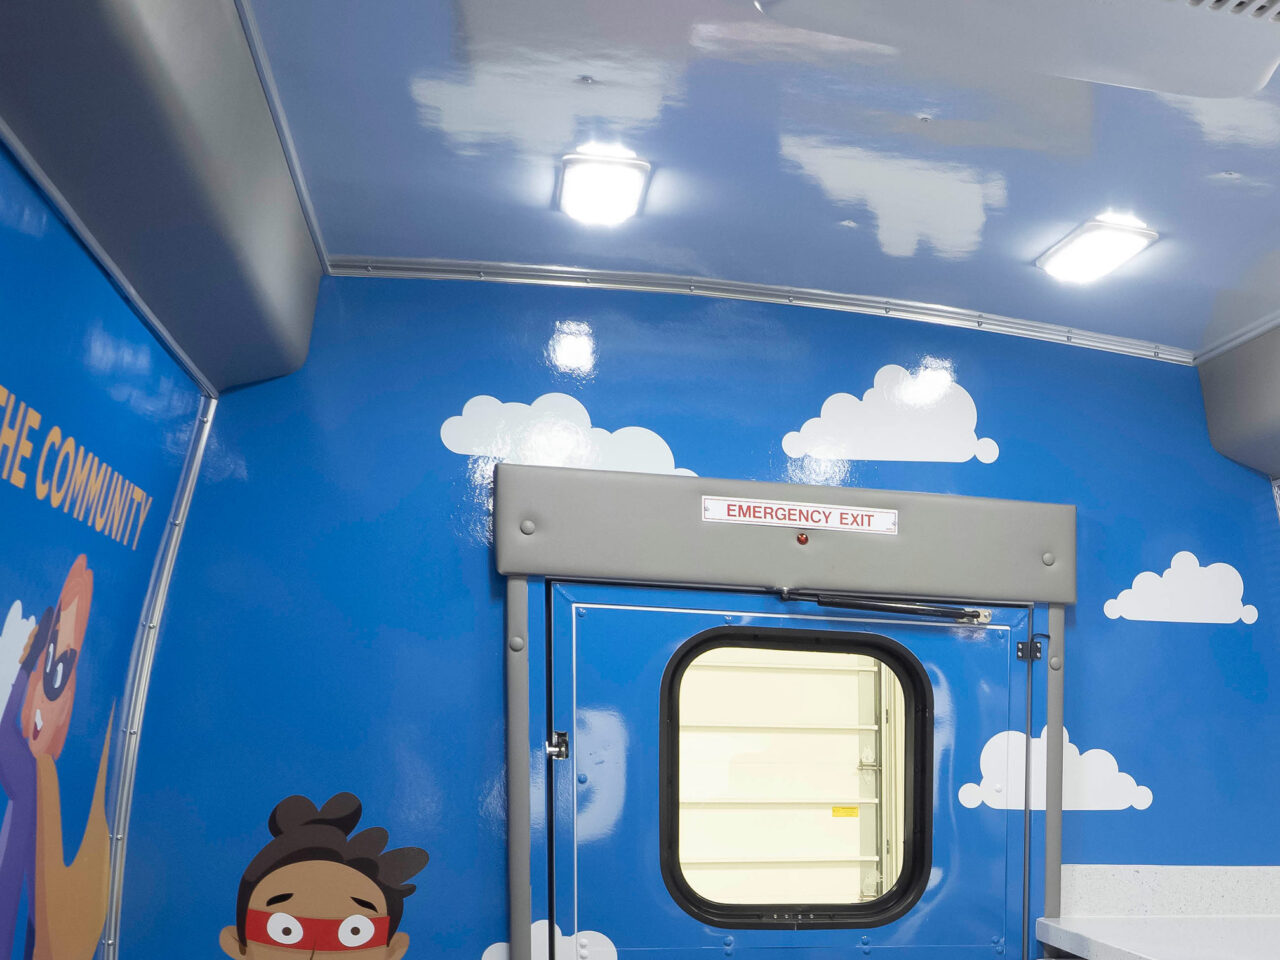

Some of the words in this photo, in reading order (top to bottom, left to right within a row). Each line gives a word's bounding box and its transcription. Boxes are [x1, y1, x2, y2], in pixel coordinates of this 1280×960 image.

[36, 425, 153, 551] COMMUNITY
[726, 503, 832, 524] EMERGENCY
[839, 512, 875, 527] EXIT
